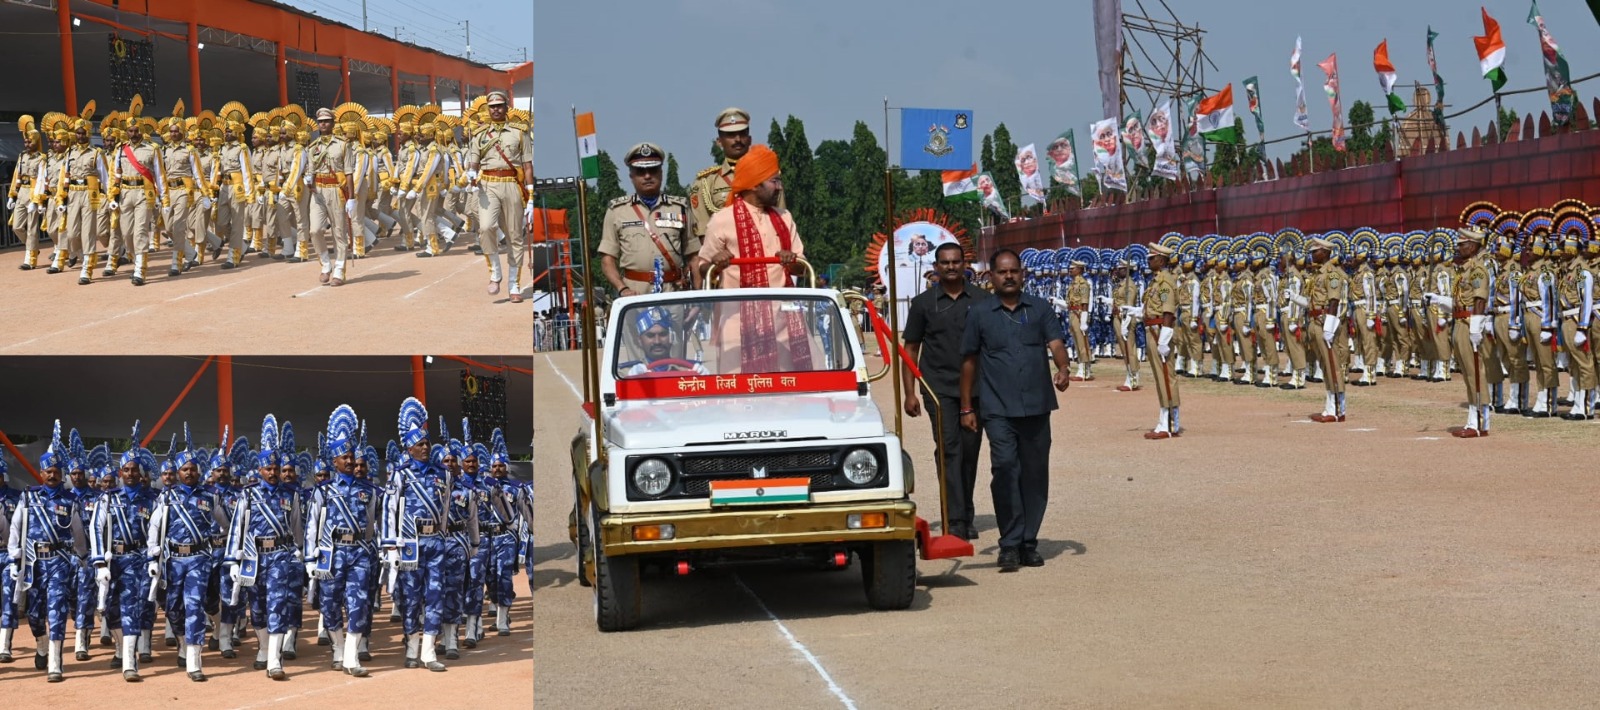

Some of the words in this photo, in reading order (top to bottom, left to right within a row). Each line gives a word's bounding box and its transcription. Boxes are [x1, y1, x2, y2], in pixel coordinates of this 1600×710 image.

[716, 374, 737, 390] रिजर्व
[747, 374, 773, 393] पुलिस
[724, 430, 787, 440] MARUTI
